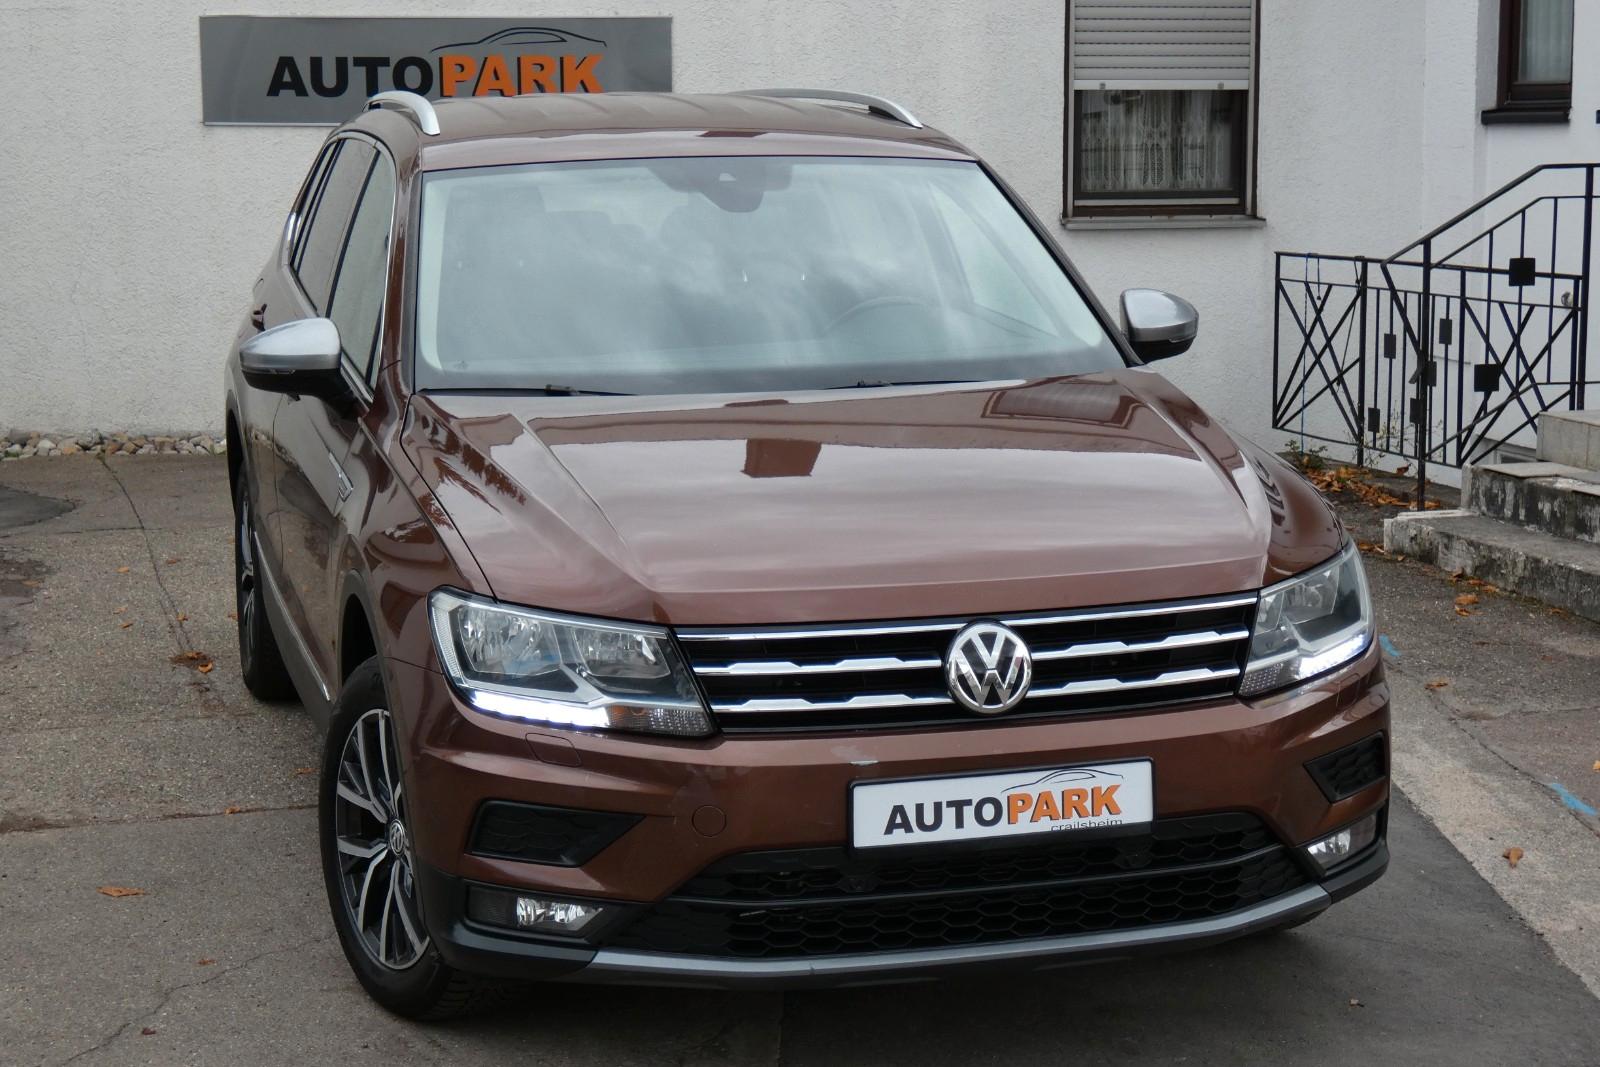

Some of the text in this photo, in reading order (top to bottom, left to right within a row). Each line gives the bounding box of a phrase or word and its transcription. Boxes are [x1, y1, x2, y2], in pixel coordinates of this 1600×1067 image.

[267, 54, 605, 97] AUTOPARK
[949, 625, 1028, 708] VW
[884, 784, 1121, 835] AUTOPARK
